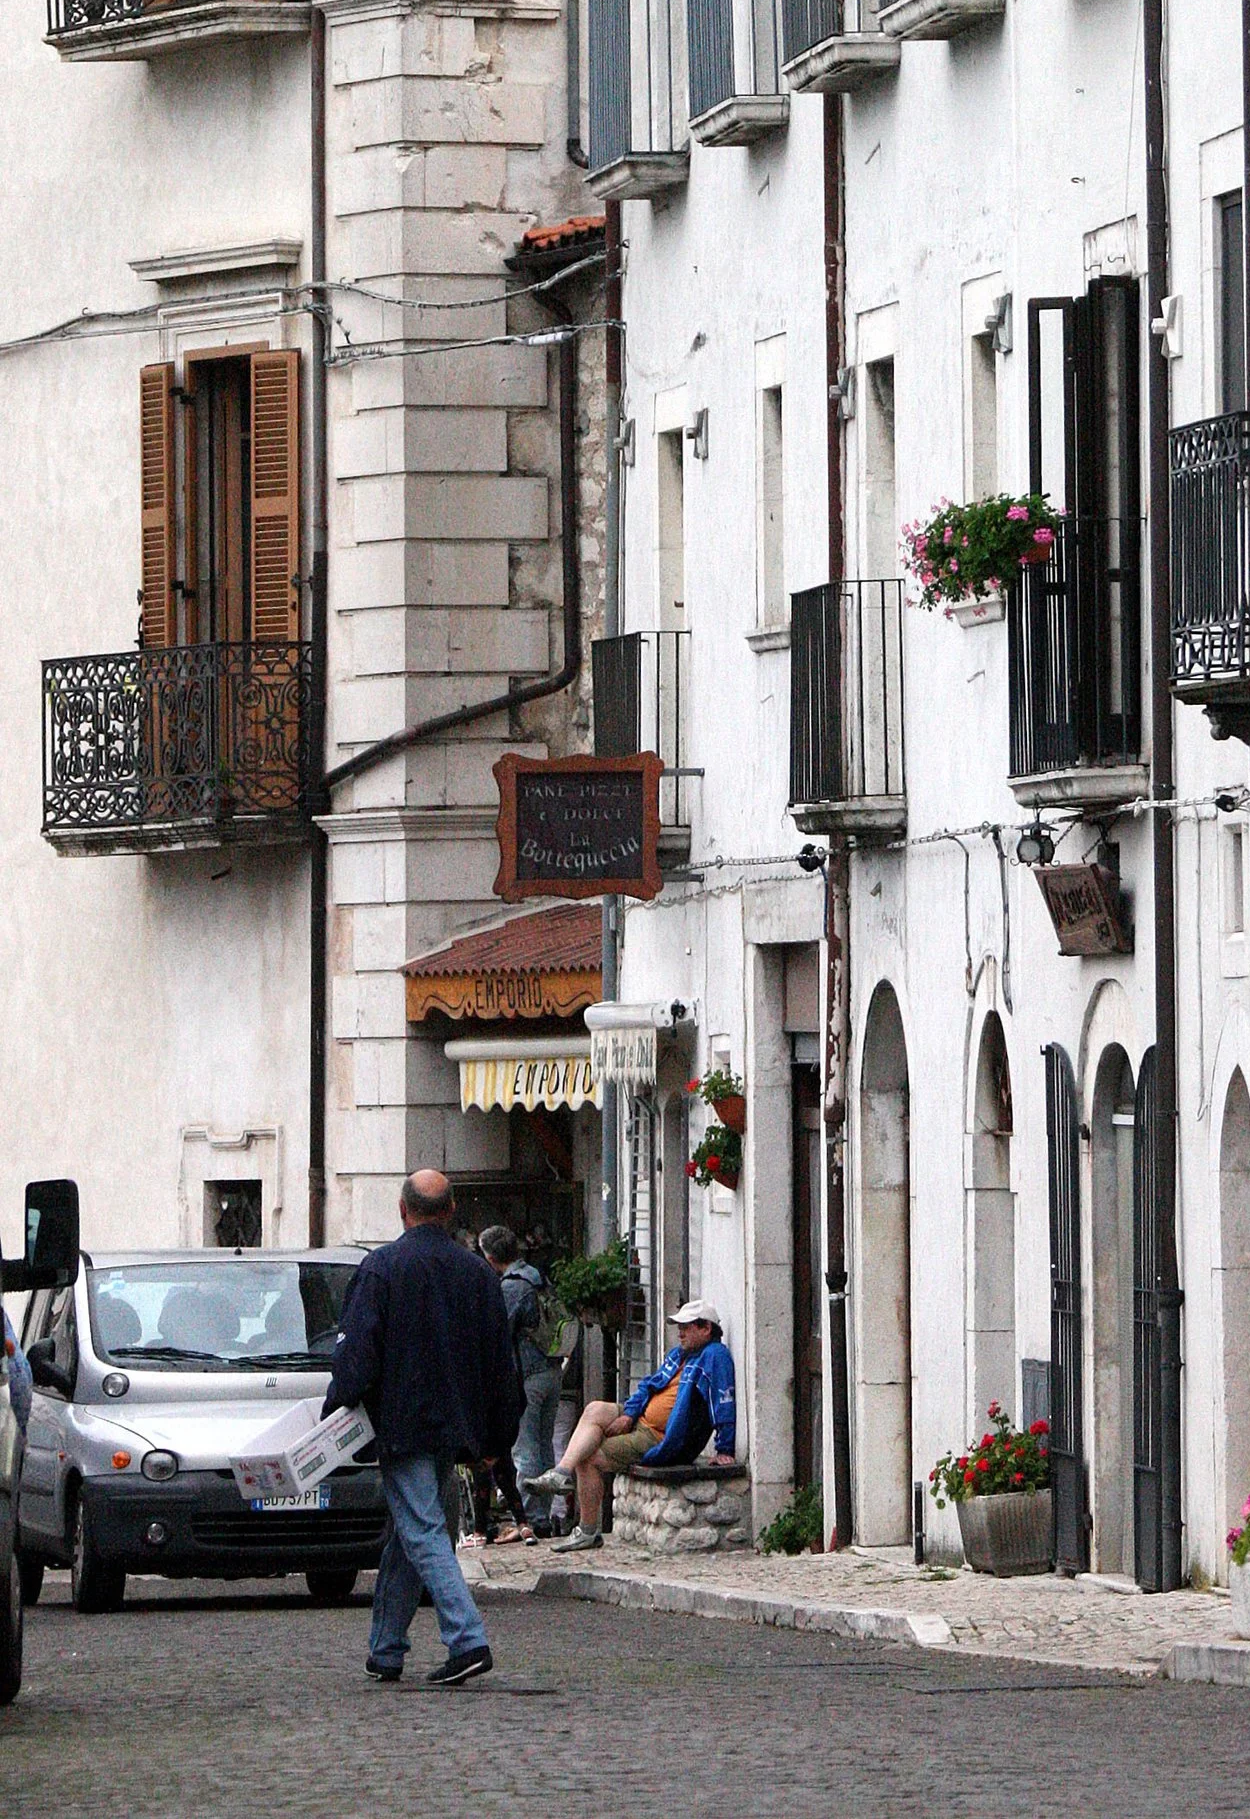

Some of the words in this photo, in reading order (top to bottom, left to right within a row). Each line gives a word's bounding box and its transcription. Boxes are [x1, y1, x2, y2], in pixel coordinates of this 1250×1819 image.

[523, 784, 567, 799] PANE
[474, 976, 544, 1010] EMPORIO
[512, 1061, 594, 1096] EMPORIO
